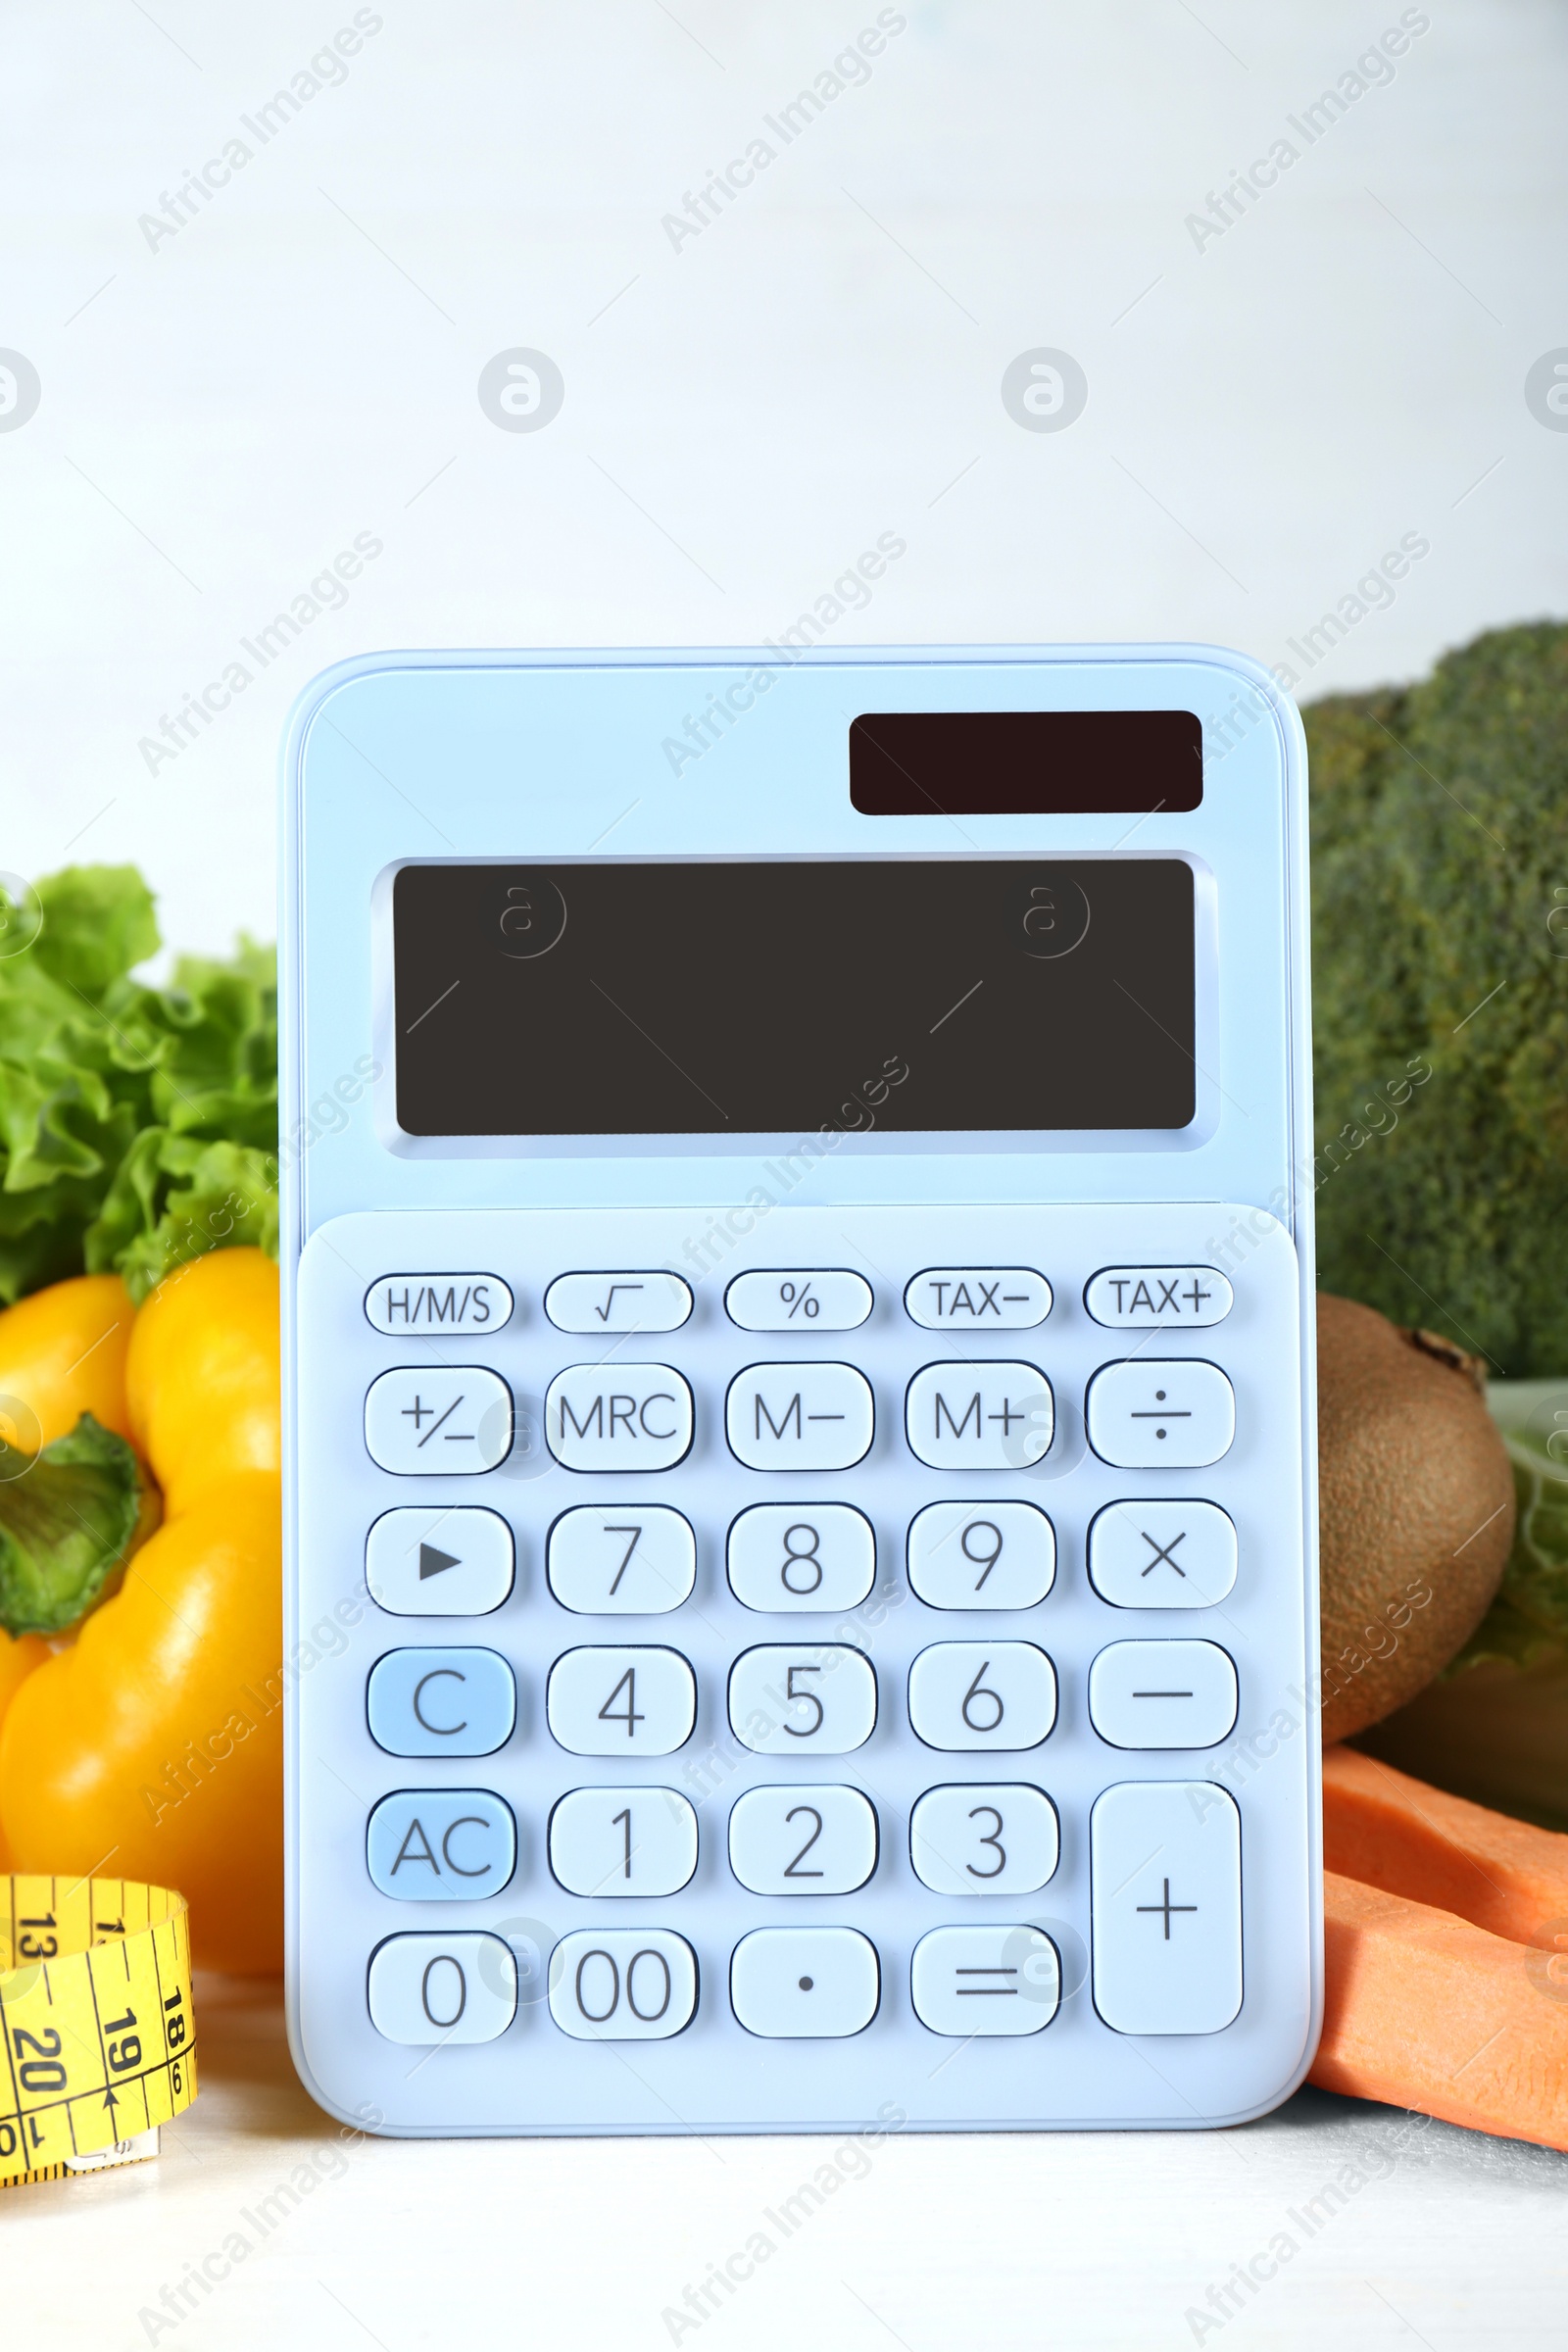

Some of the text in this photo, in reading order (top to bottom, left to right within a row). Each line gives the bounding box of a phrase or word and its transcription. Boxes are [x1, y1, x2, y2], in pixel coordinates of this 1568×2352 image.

[387, 1285, 490, 1324] H/M/S
[779, 1282, 820, 1319] %
[1108, 1278, 1211, 1314] TAX+
[560, 1393, 677, 1440] MRC
[935, 1392, 1026, 1440] M+
[603, 1526, 643, 1596] 7
[780, 1523, 823, 1595] 8
[960, 1520, 1004, 1592] 9
[413, 1669, 467, 1736] C
[598, 1667, 646, 1738] 4
[782, 1666, 824, 1738] 5
[961, 1661, 1004, 1733] 6
[390, 1816, 492, 1878] AC
[612, 1808, 631, 1879] 1
[783, 1805, 824, 1878] 2
[965, 1805, 1006, 1879] 3
[20, 1912, 58, 1959] 13
[95, 1918, 125, 1945] 1
[164, 1985, 185, 2049] 18
[421, 1954, 467, 2028] 0
[575, 1948, 671, 2023] 00
[12, 2028, 68, 2092] 20
[104, 2007, 142, 2073] 19
